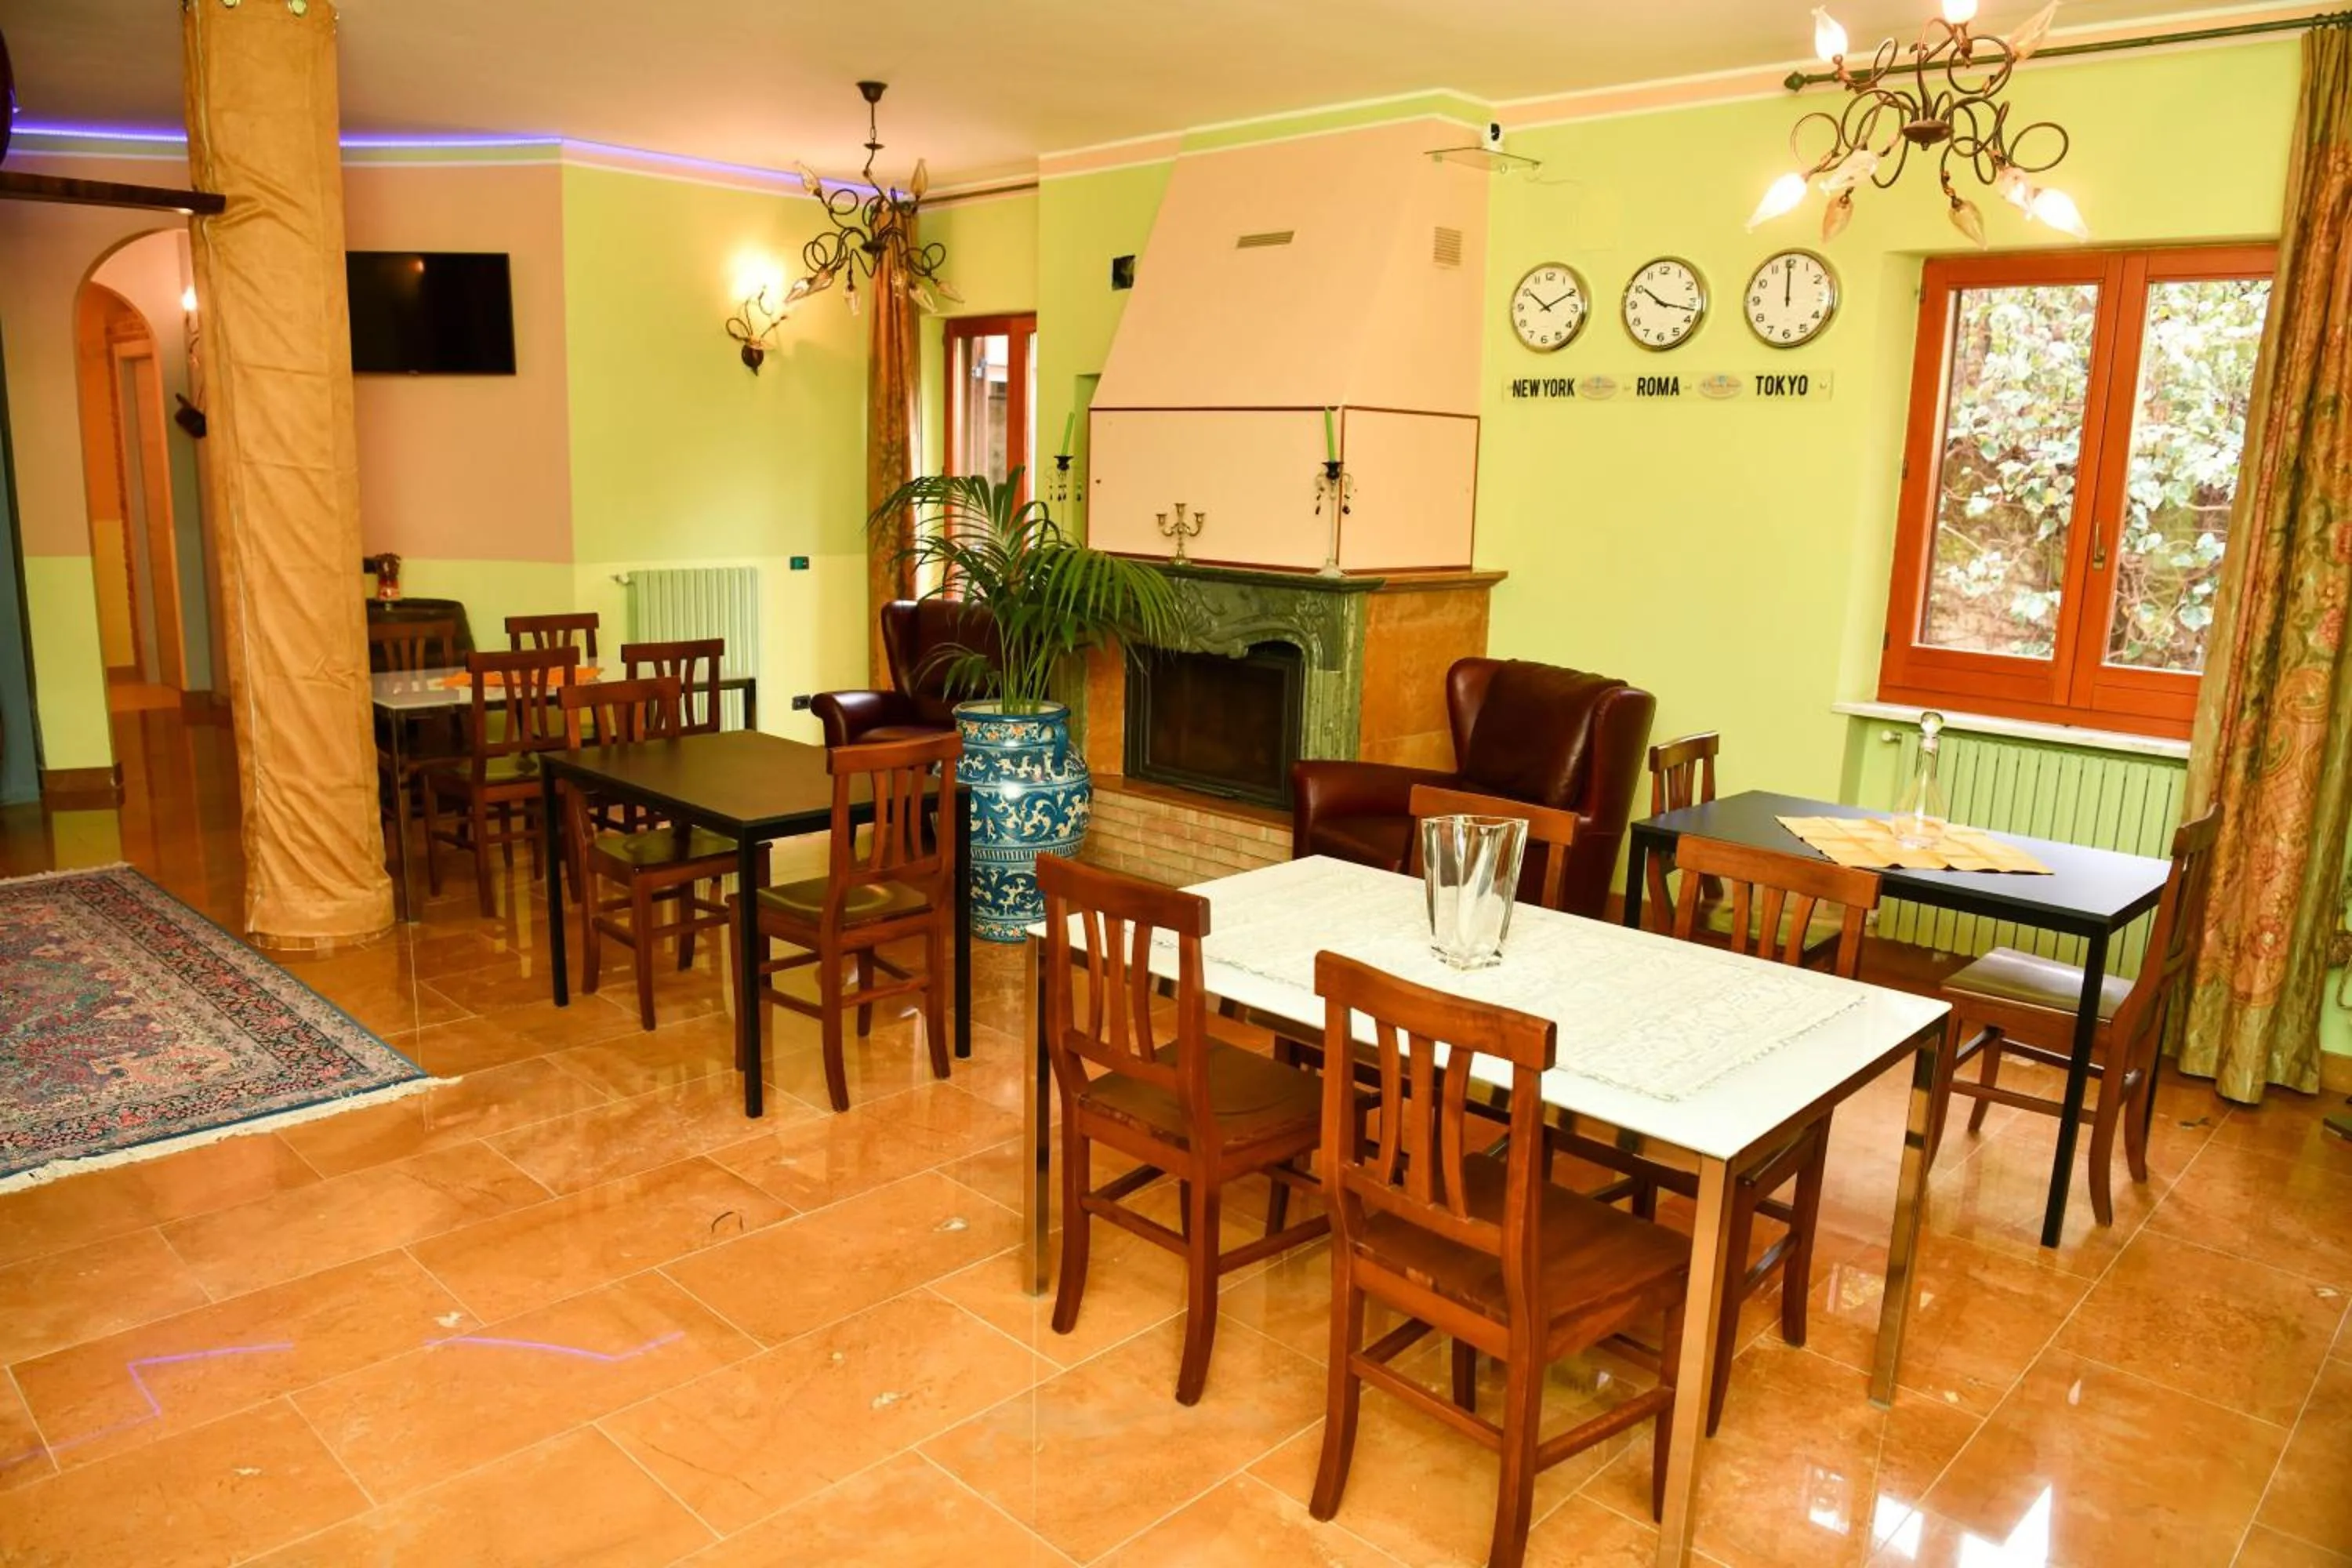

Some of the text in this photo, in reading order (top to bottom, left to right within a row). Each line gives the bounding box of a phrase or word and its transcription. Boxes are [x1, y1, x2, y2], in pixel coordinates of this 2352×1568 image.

[1660, 266, 1670, 274] 12
[1772, 265, 1779, 274] 11
[1546, 272, 1555, 281] 12
[1647, 271, 1653, 281] 11
[1813, 274, 1823, 285] 2
[1686, 281, 1694, 290] 2
[1759, 278, 1768, 289] 10
[1635, 285, 1644, 294] 10
[1630, 300, 1638, 310] 9
[1752, 296, 1761, 306] 9
[1518, 303, 1524, 312] 9
[1570, 304, 1578, 314] 3
[1755, 314, 1764, 323] 8
[1811, 310, 1820, 319] 4
[1519, 319, 1526, 328] 8
[1565, 320, 1572, 328] 4
[1632, 317, 1641, 326] 8
[1683, 315, 1691, 324] 4
[1671, 327, 1680, 336] 5
[1766, 325, 1774, 335] 7
[1798, 323, 1808, 333] 5
[1528, 330, 1535, 339] 7
[1555, 331, 1562, 340] 5
[1643, 328, 1650, 338] 7
[1657, 332, 1664, 342] 6
[1782, 329, 1791, 339] 6
[1512, 379, 1541, 397] NEW
[1542, 378, 1575, 397] YORK
[1636, 376, 1679, 397] ROMA
[1755, 375, 1809, 396] TOKYO
